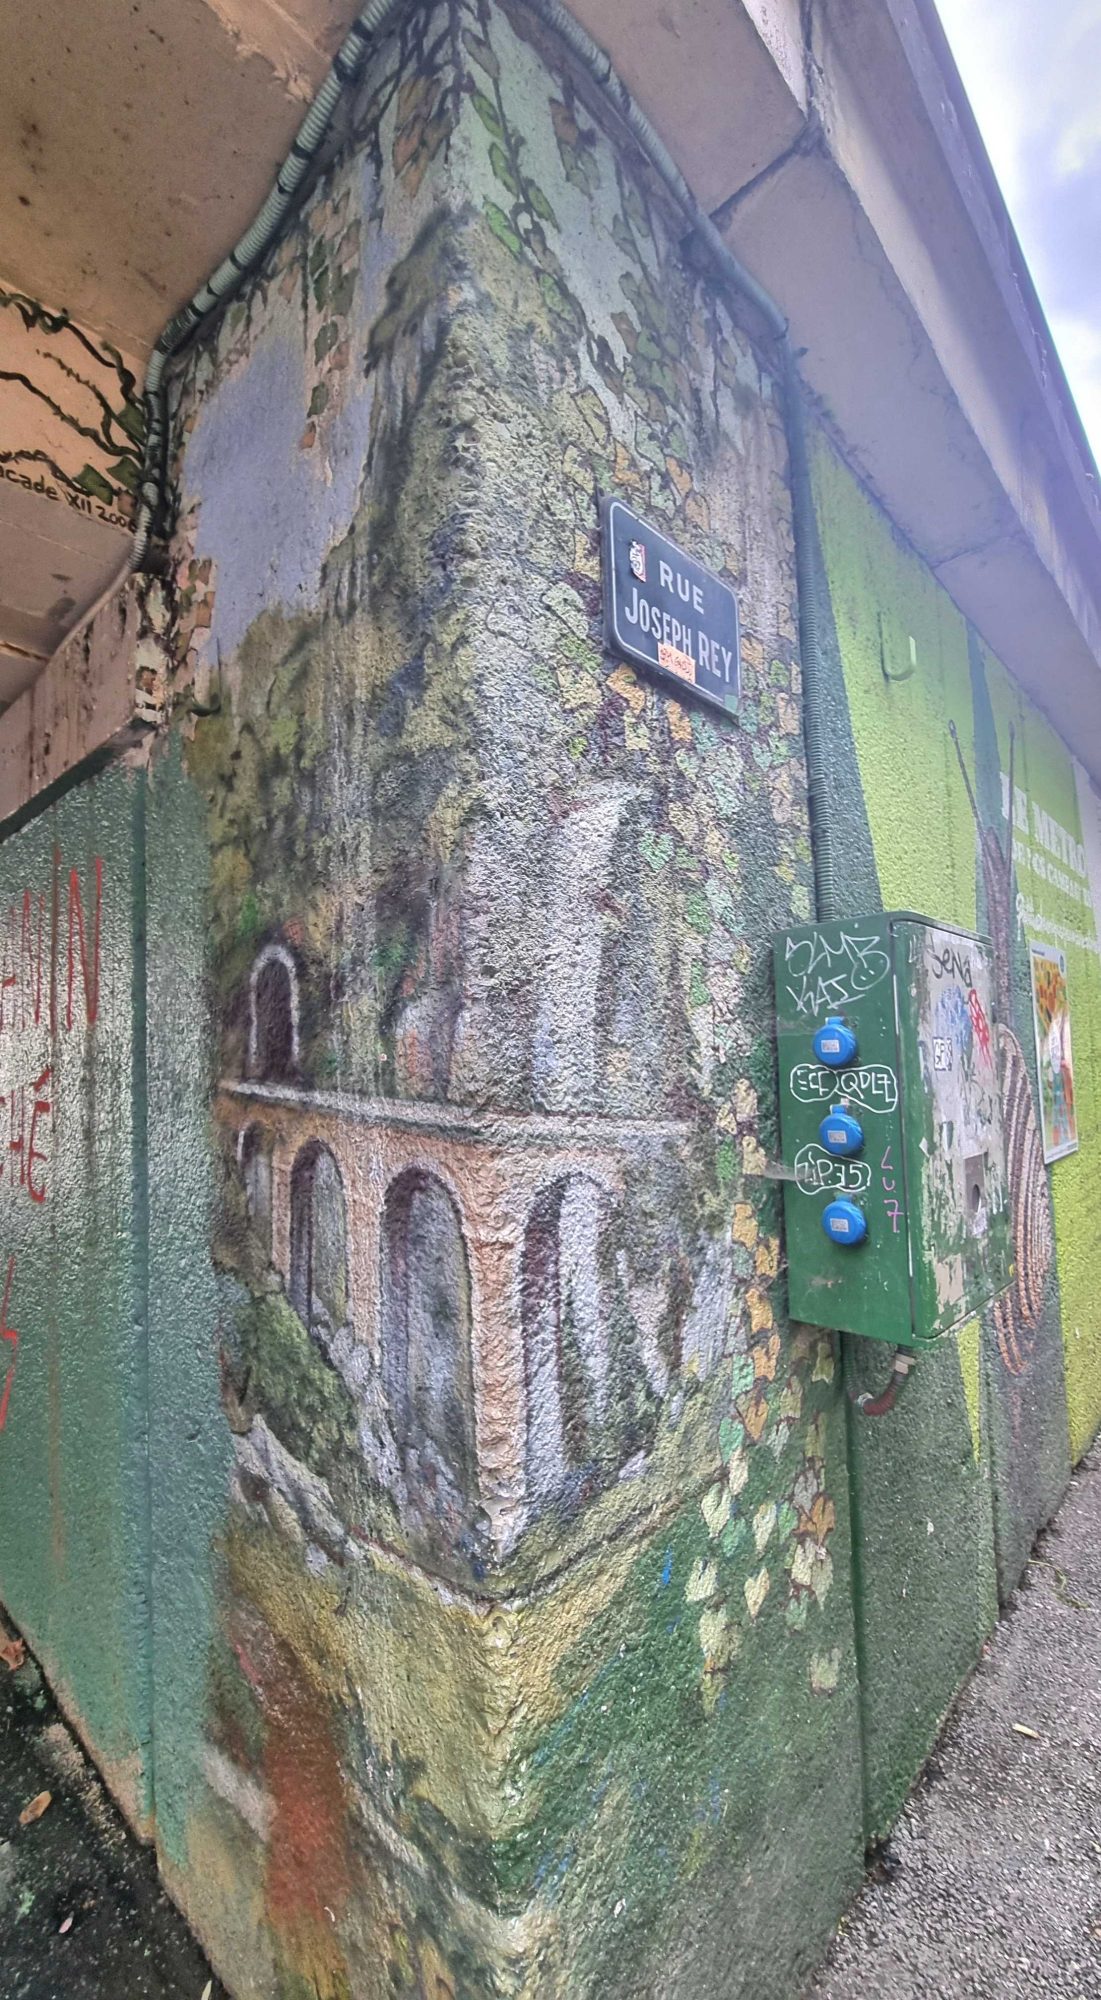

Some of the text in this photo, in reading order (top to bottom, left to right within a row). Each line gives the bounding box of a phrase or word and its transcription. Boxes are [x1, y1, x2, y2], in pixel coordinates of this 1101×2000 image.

[659, 560, 705, 614] RUE
[624, 587, 693, 658] JOSEPH
[698, 630, 733, 683] REY
